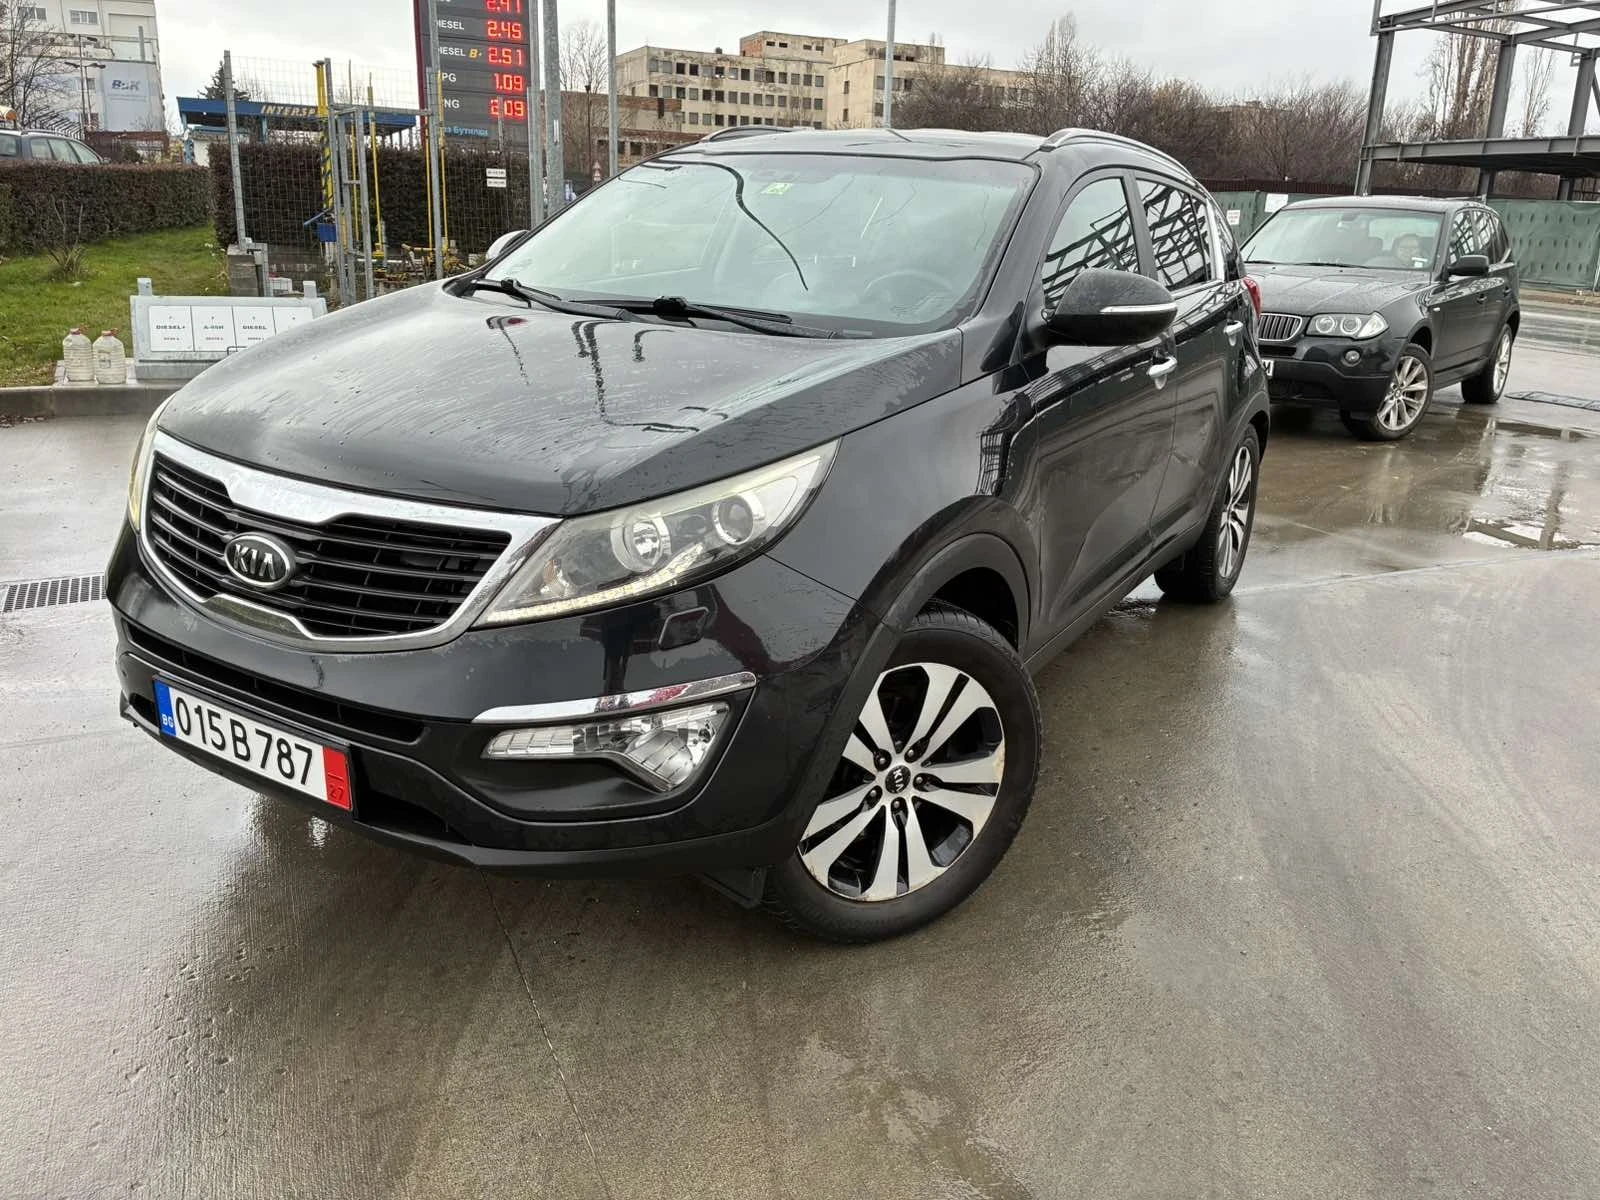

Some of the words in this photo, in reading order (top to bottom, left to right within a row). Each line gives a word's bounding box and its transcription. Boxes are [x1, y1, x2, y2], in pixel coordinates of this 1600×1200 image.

[487, 20, 522, 39] 2.45
[488, 47, 523, 65] 2.51
[494, 72, 523, 91] 1.09
[233, 543, 276, 580] KIA
[162, 713, 174, 728] BG
[893, 768, 904, 792] KIA
